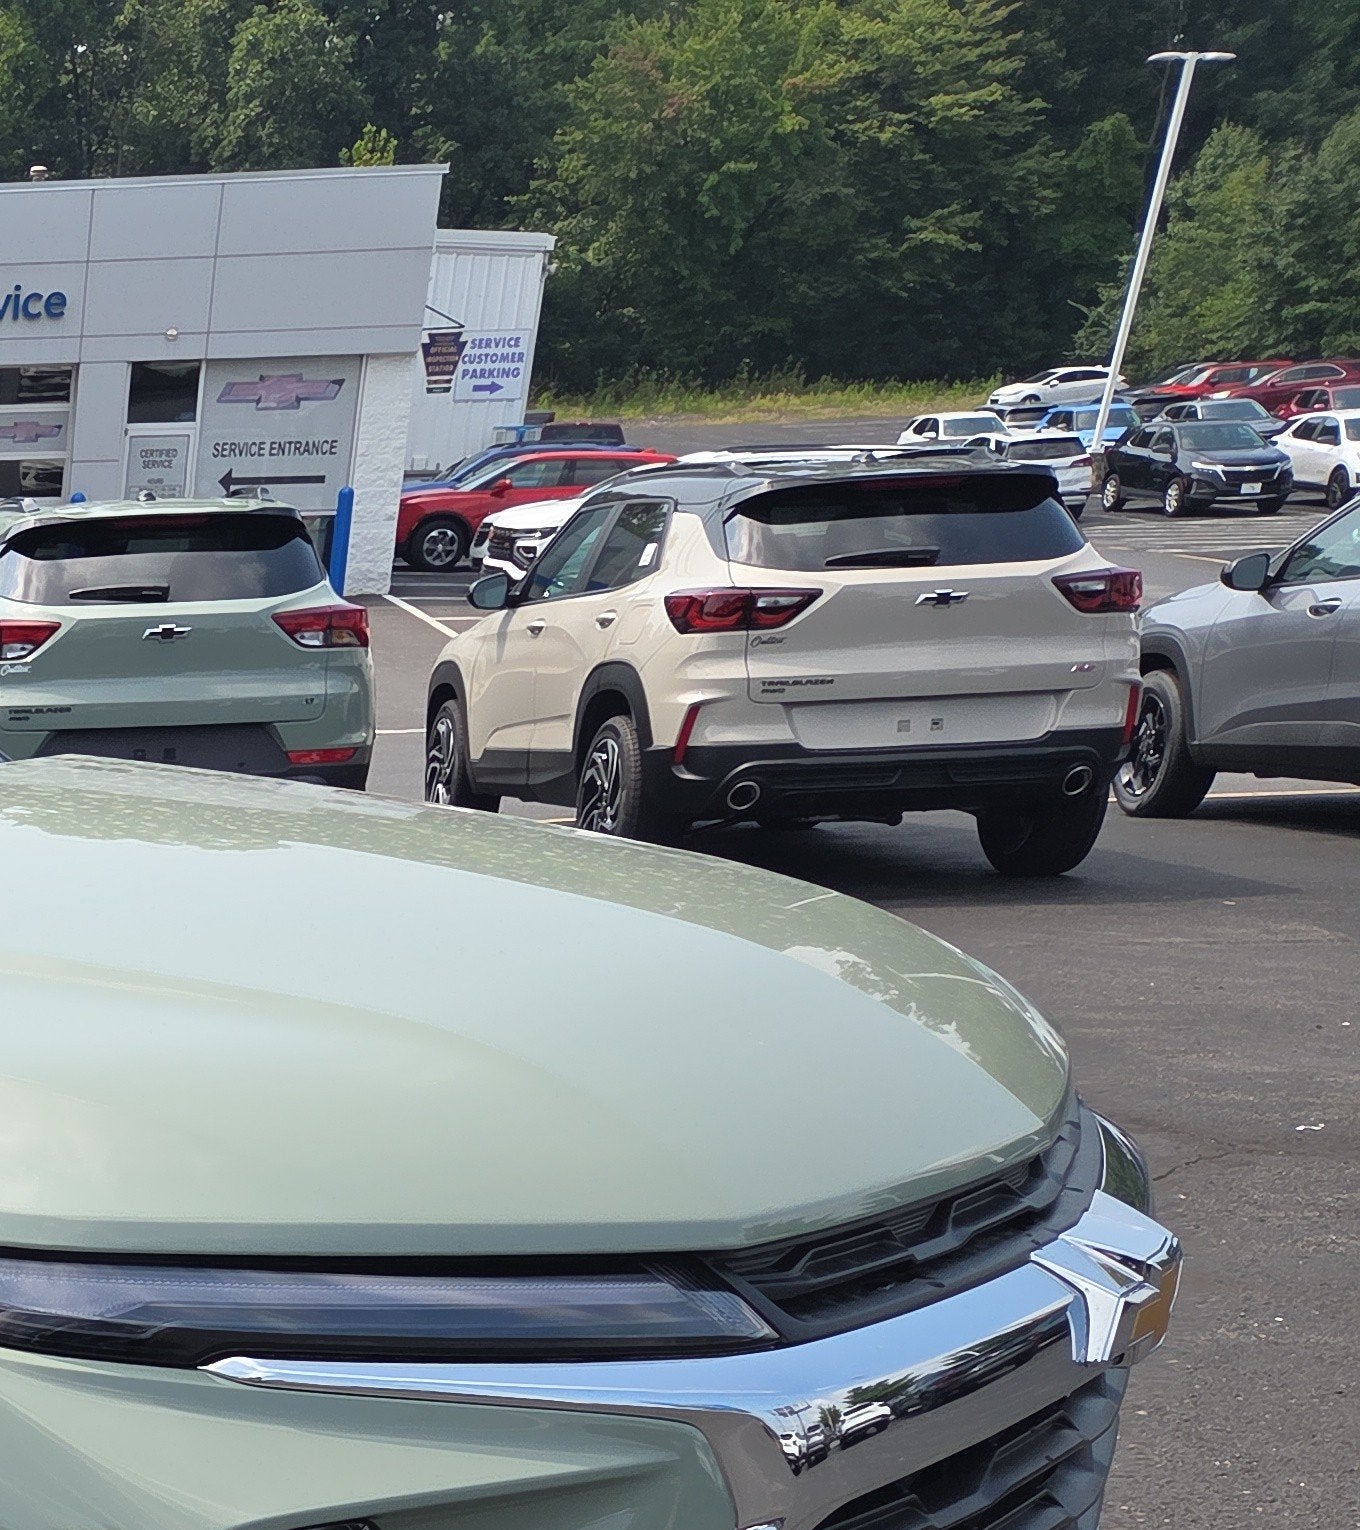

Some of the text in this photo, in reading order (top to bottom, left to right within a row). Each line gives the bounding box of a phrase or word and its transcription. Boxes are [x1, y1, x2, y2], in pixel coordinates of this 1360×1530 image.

[470, 336, 521, 349] SERVICE
[461, 351, 525, 365] CUSTOMER
[461, 367, 521, 380] PARKING
[139, 448, 178, 459] CERTIFIED
[212, 439, 338, 458] SERVICE ENTRANCE
[141, 458, 174, 470] SERVICE
